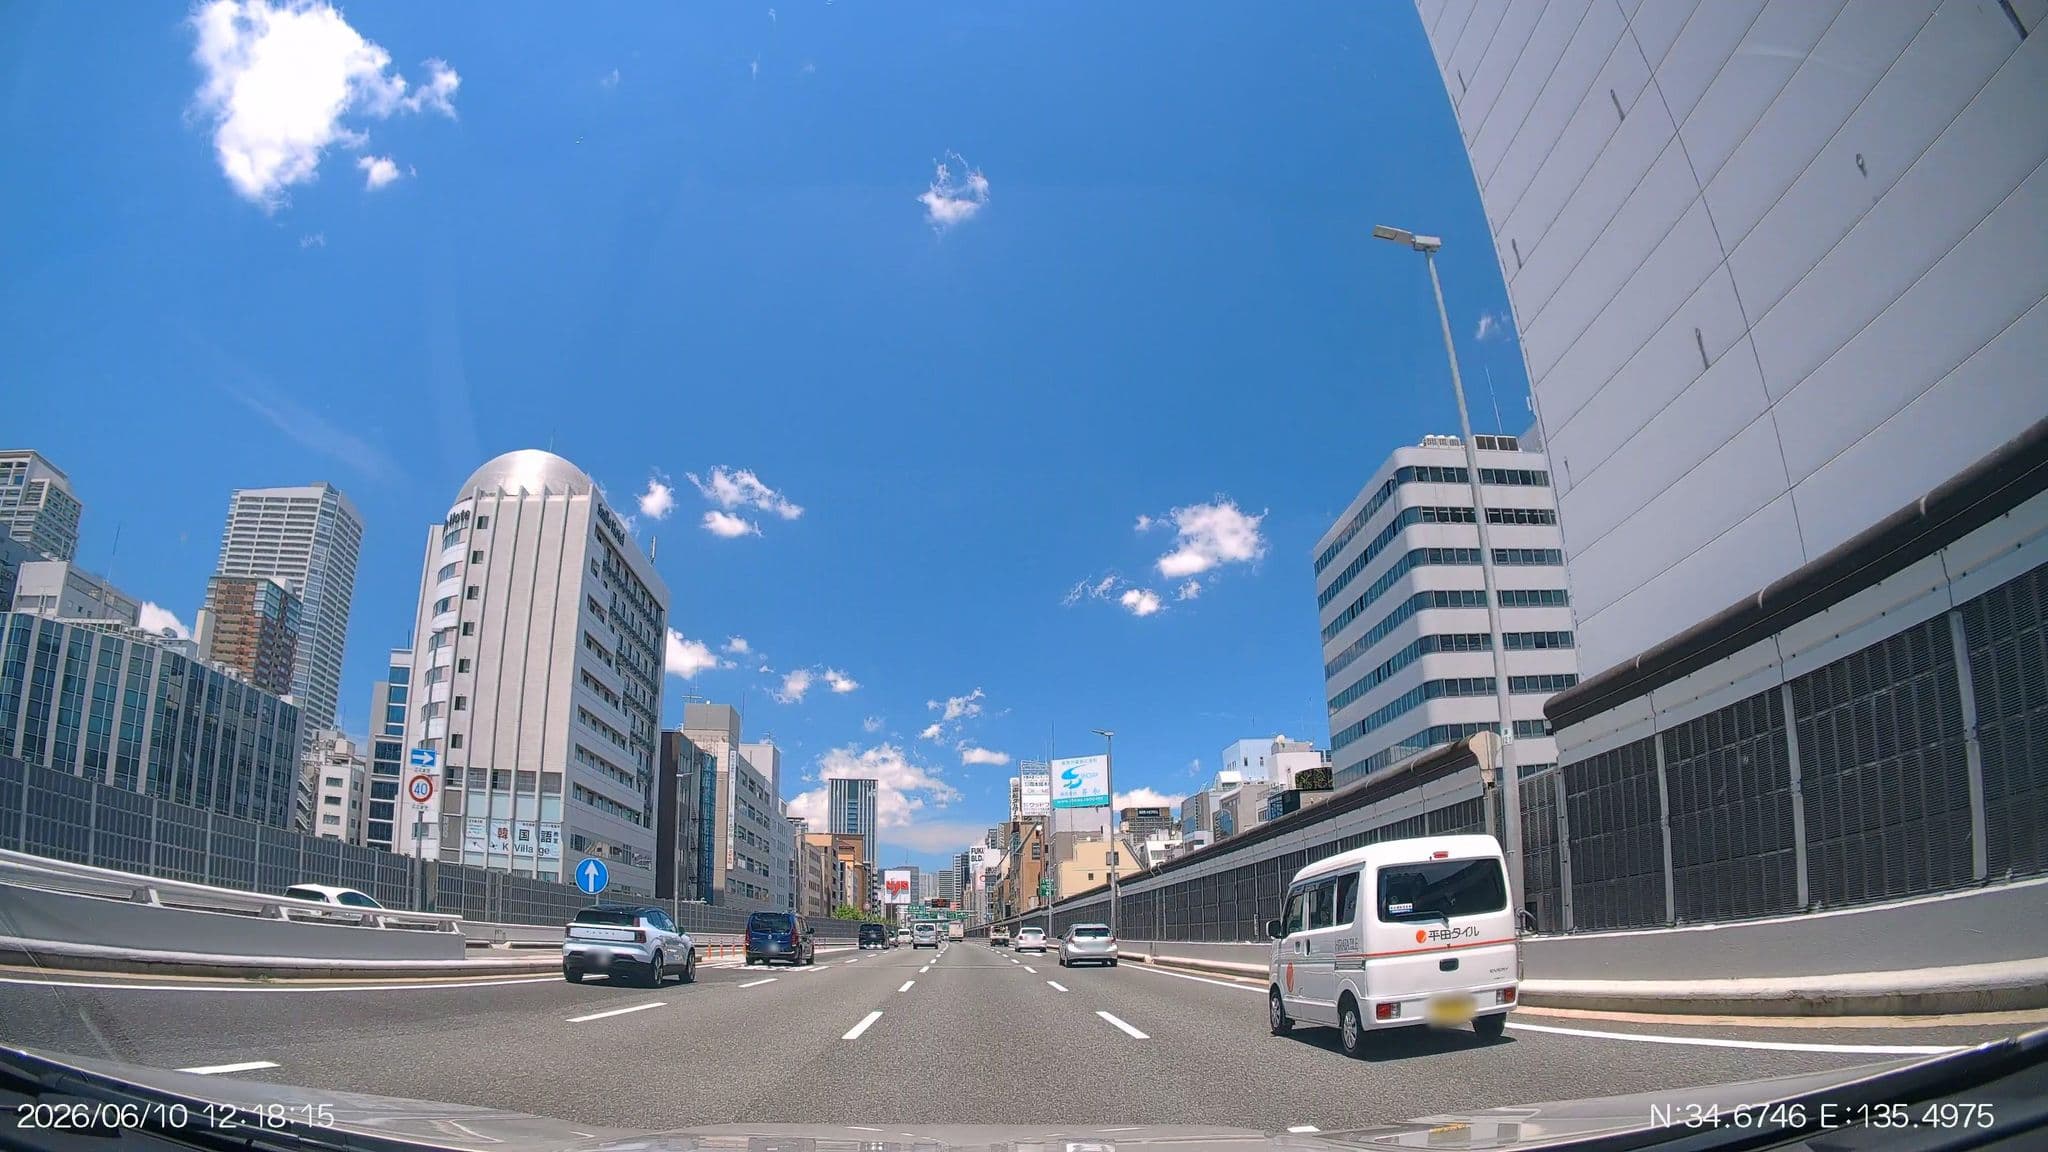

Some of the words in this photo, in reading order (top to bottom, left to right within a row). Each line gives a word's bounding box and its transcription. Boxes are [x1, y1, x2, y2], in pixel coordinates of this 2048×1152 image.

[414, 782, 428, 795] 40
[513, 843, 550, 856] Village
[1428, 926, 1480, 942] 平田タイル
